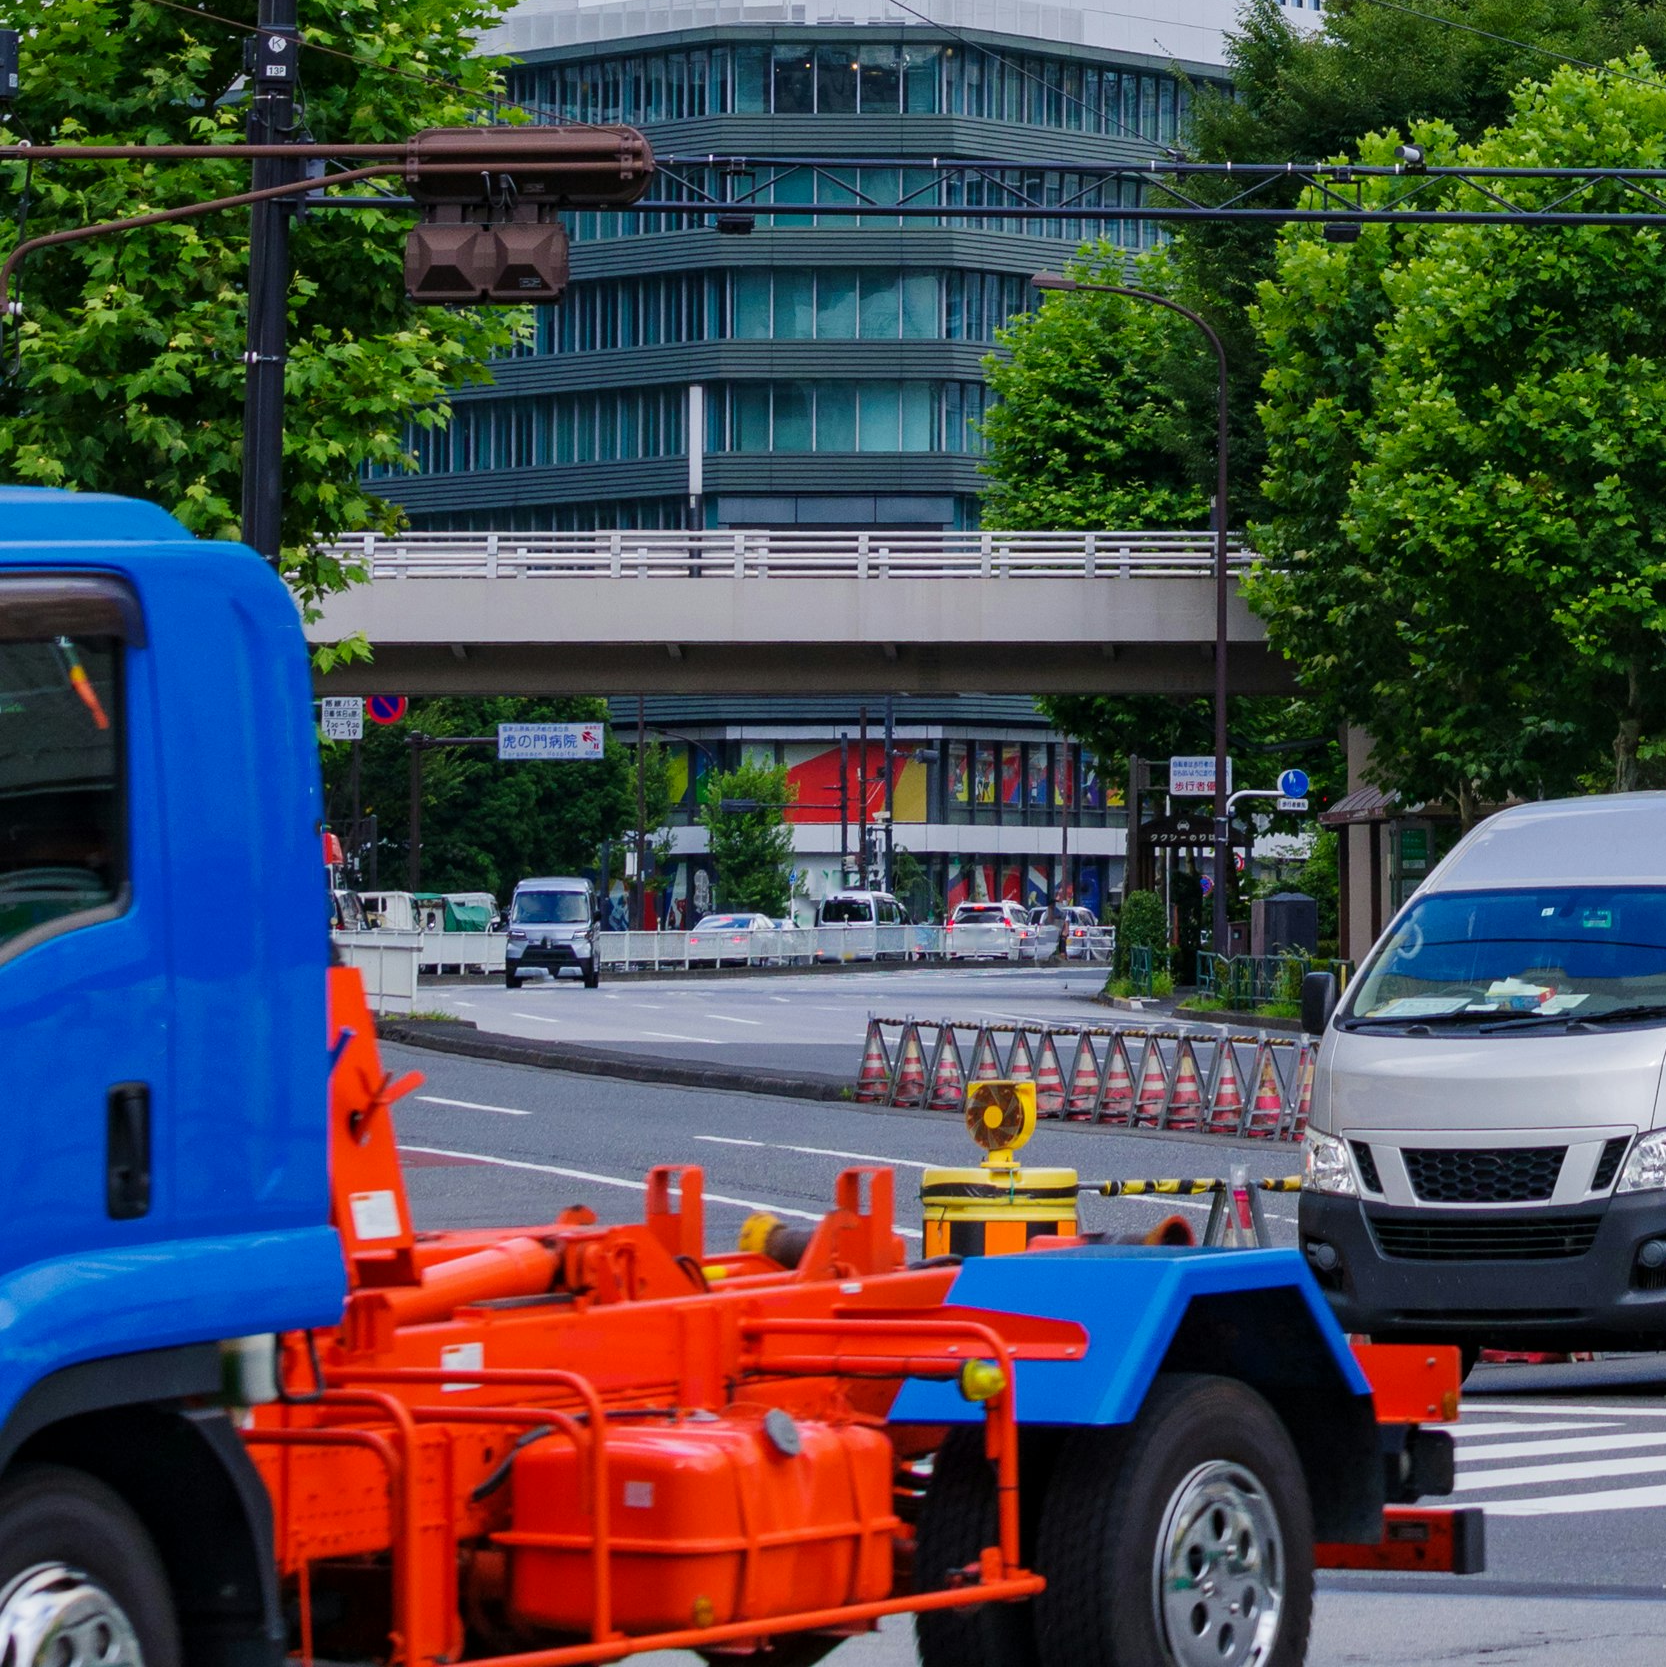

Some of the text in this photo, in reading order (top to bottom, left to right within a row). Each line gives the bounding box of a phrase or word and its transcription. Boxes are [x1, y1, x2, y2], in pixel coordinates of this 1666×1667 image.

[269, 67, 285, 75] 13P
[503, 734, 578, 748] 虎の門病院
[1175, 781, 1217, 792] 歩行者優
